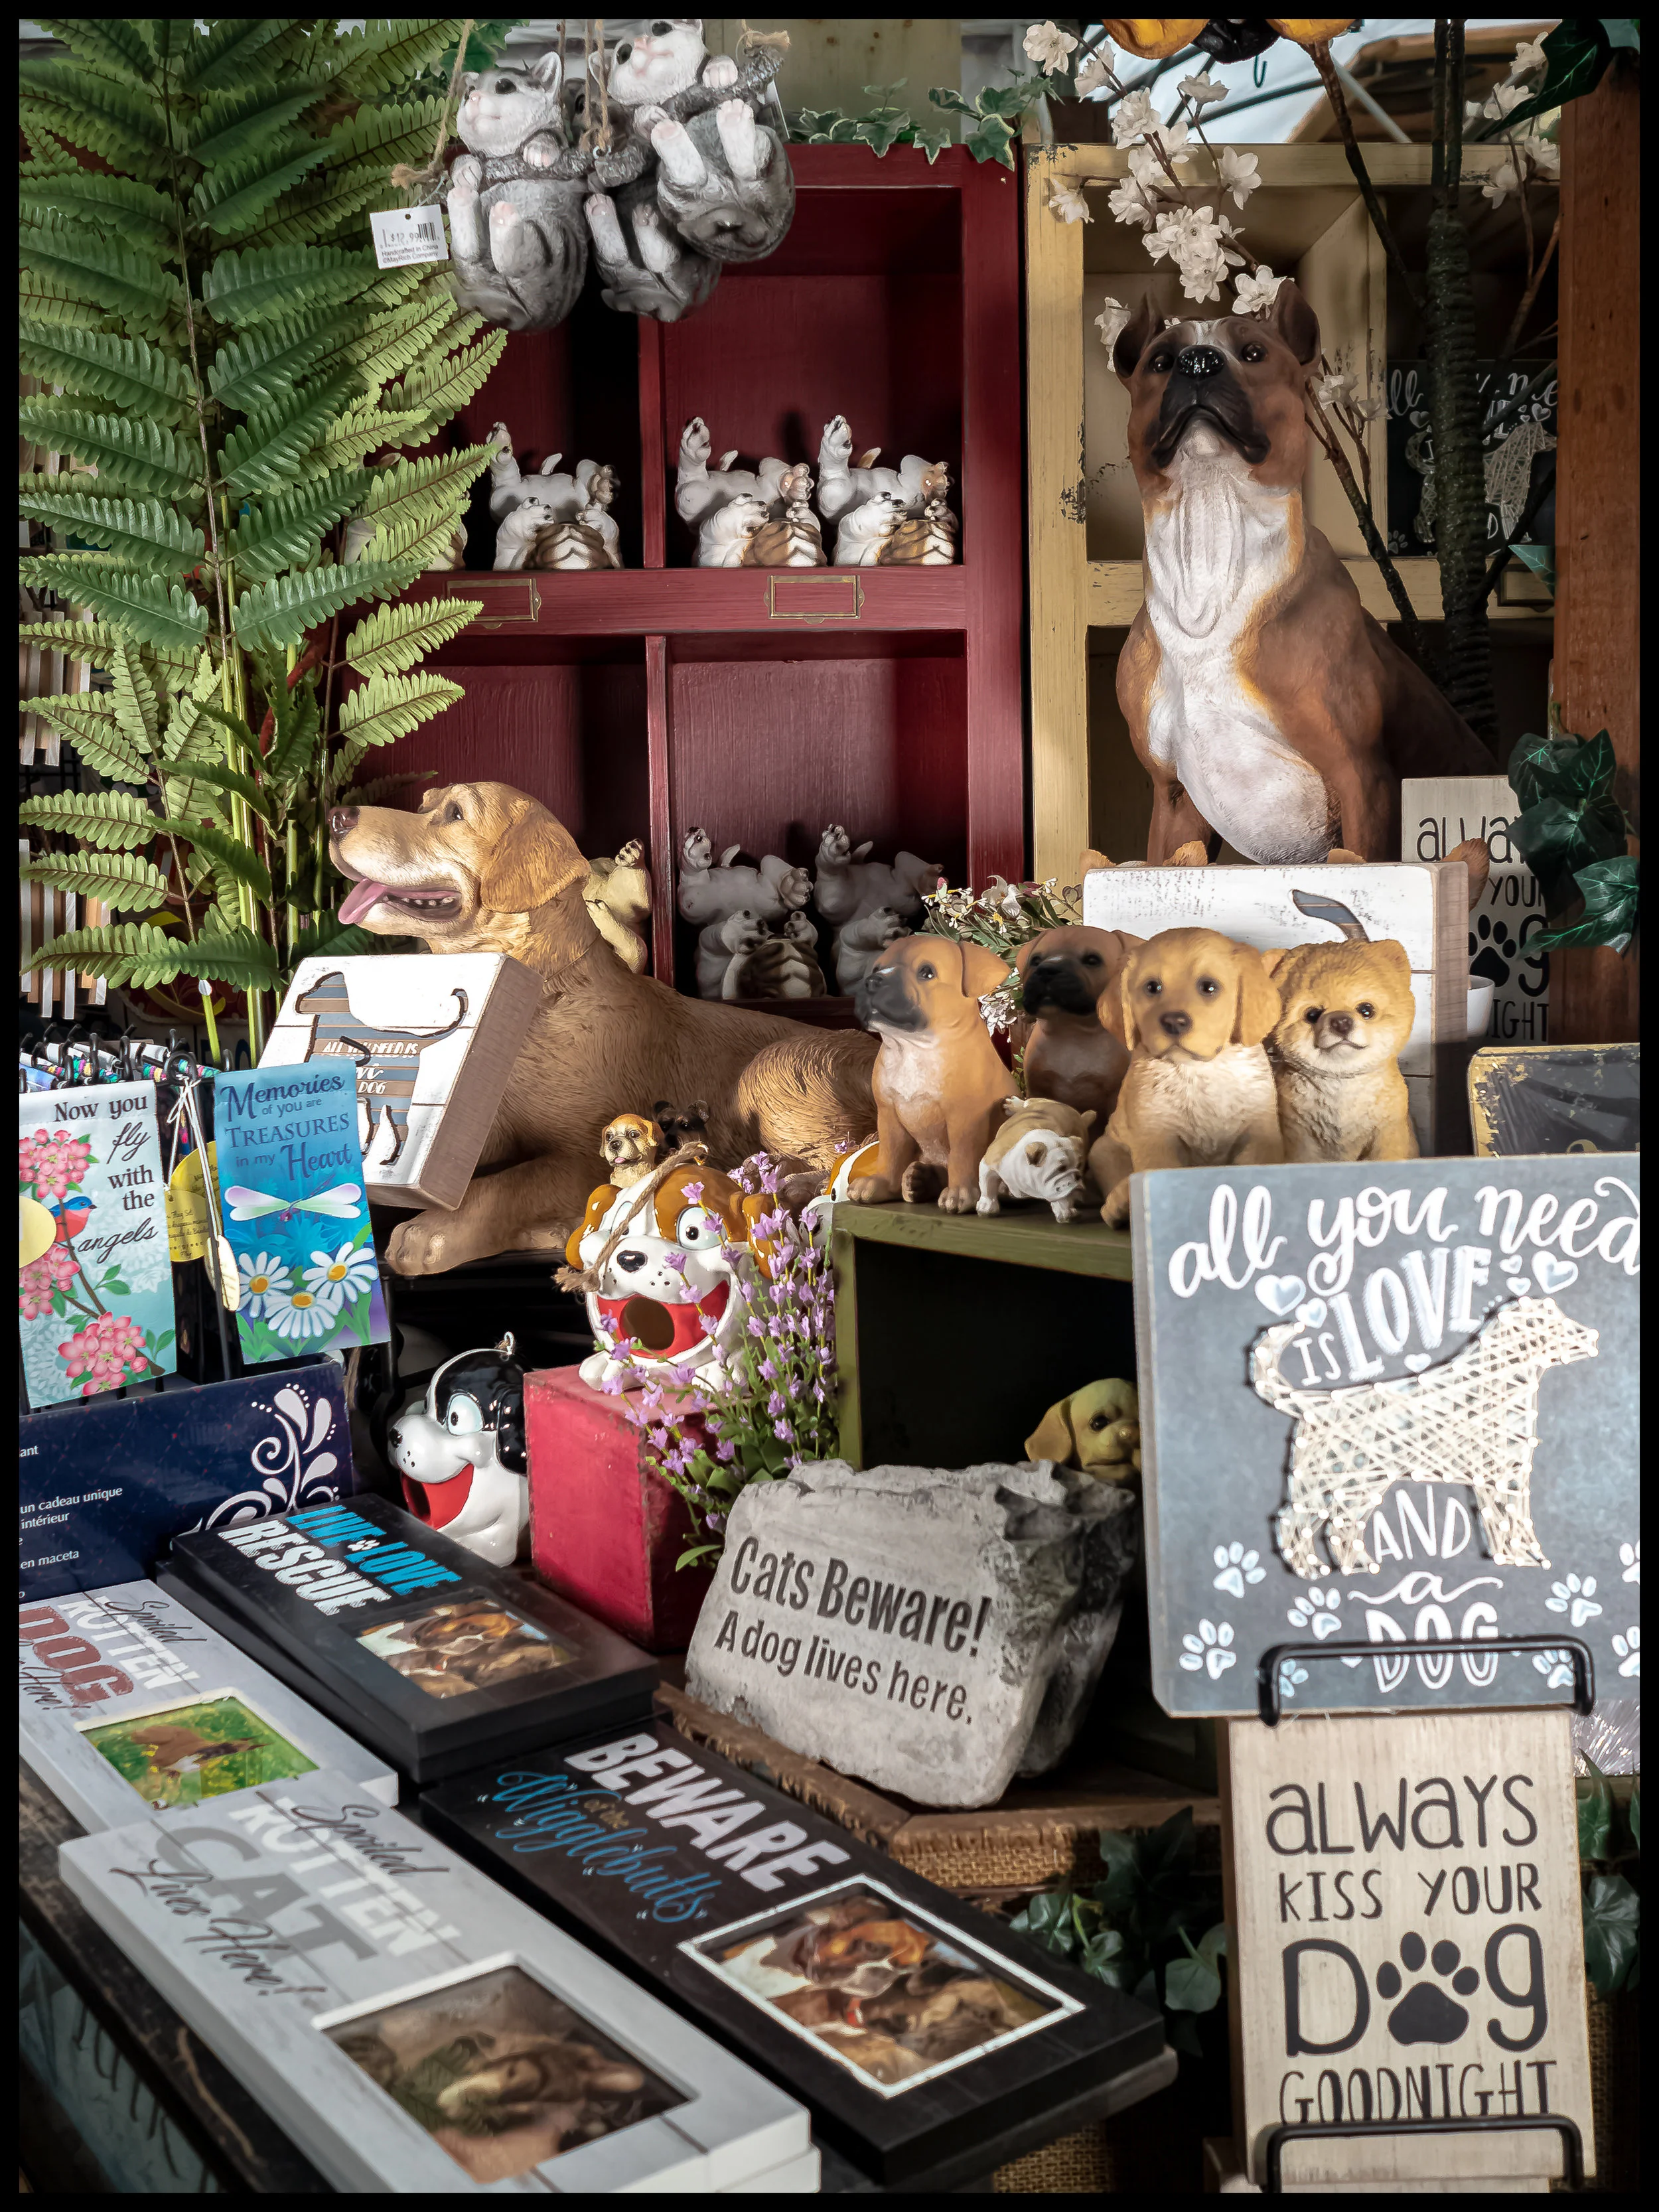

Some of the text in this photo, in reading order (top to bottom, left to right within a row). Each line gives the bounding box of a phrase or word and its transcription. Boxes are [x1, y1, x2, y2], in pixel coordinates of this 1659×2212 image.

[382, 247, 415, 257] Handcrafted
[390, 232, 419, 245] $12.99
[1488, 875, 1542, 908] YOU
[404, 1043, 419, 1059] IS
[53, 1096, 148, 1122] Now you
[220, 1074, 346, 1122] Memories
[261, 1098, 323, 1118] of you are
[358, 1081, 388, 1094] DOG
[106, 1121, 151, 1165] fly
[224, 1112, 350, 1149] TREASURES
[108, 1164, 155, 1189] with
[236, 1142, 353, 1181] in my Heart
[121, 1190, 155, 1211] the
[78, 1217, 159, 1264] angels
[1168, 1183, 1288, 1298] all
[1306, 1185, 1459, 1296] you
[1293, 1244, 1494, 1386] IS LOVE
[19, 1445, 39, 1457] ant
[20, 1487, 123, 1514] un cadeau unique
[21, 1511, 70, 1530] intérieur
[1372, 1484, 1471, 1563] AND
[20, 1550, 80, 1570] en maceta
[217, 1518, 392, 1617] RESCUE
[285, 1505, 463, 1596] LIVE LOVE
[730, 1535, 993, 1659] Cats Beware!
[19, 1605, 134, 1704] DOG
[57, 1594, 201, 1690] ROTTEN
[1365, 1601, 1500, 1693] DOG
[713, 1610, 972, 1726] A dog lives here.
[563, 1732, 851, 1892] BEWARE
[492, 1771, 723, 1923] Wigglebutts
[155, 1826, 378, 1964] CAT
[228, 1796, 461, 1956] ROTTEN
[1279, 1862, 1543, 1923] KISS YOUR
[182, 1917, 327, 1996] Here!
[1279, 2059, 1557, 2126] GOODNIGHT
